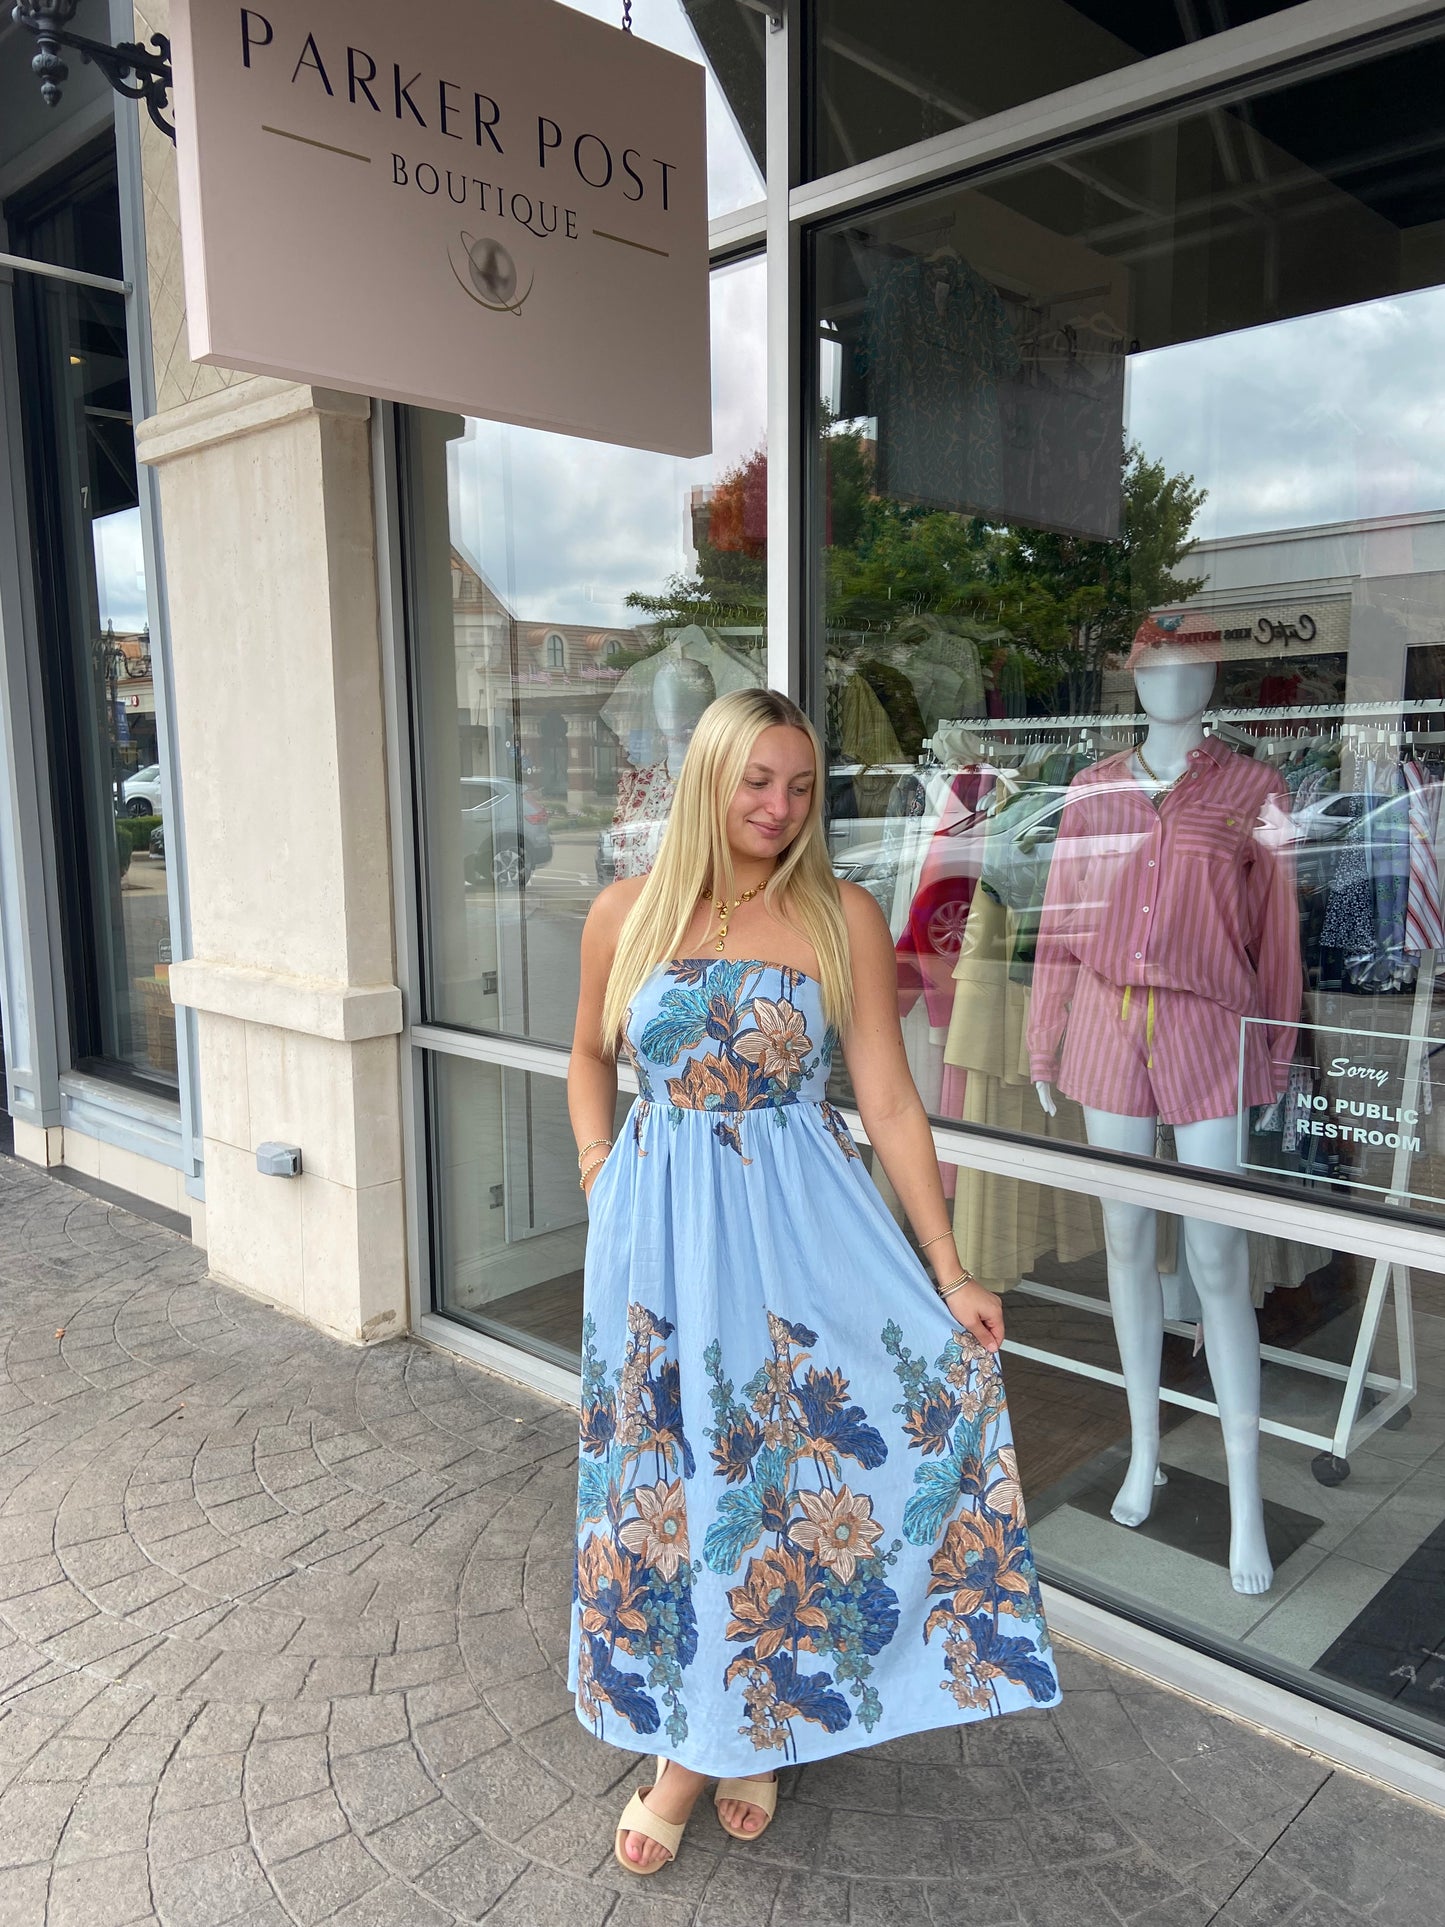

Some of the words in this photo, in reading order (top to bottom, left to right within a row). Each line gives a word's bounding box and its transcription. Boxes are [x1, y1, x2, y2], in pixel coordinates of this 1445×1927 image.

[240, 7, 504, 155] PARKER
[537, 115, 677, 211] POST
[391, 152, 579, 239] BOUTIQUE
[1326, 1057, 1389, 1088] Sorry
[1297, 1093, 1328, 1111] NO
[1335, 1098, 1419, 1125] PUBLIC
[1296, 1118, 1421, 1152] RESTROOM
